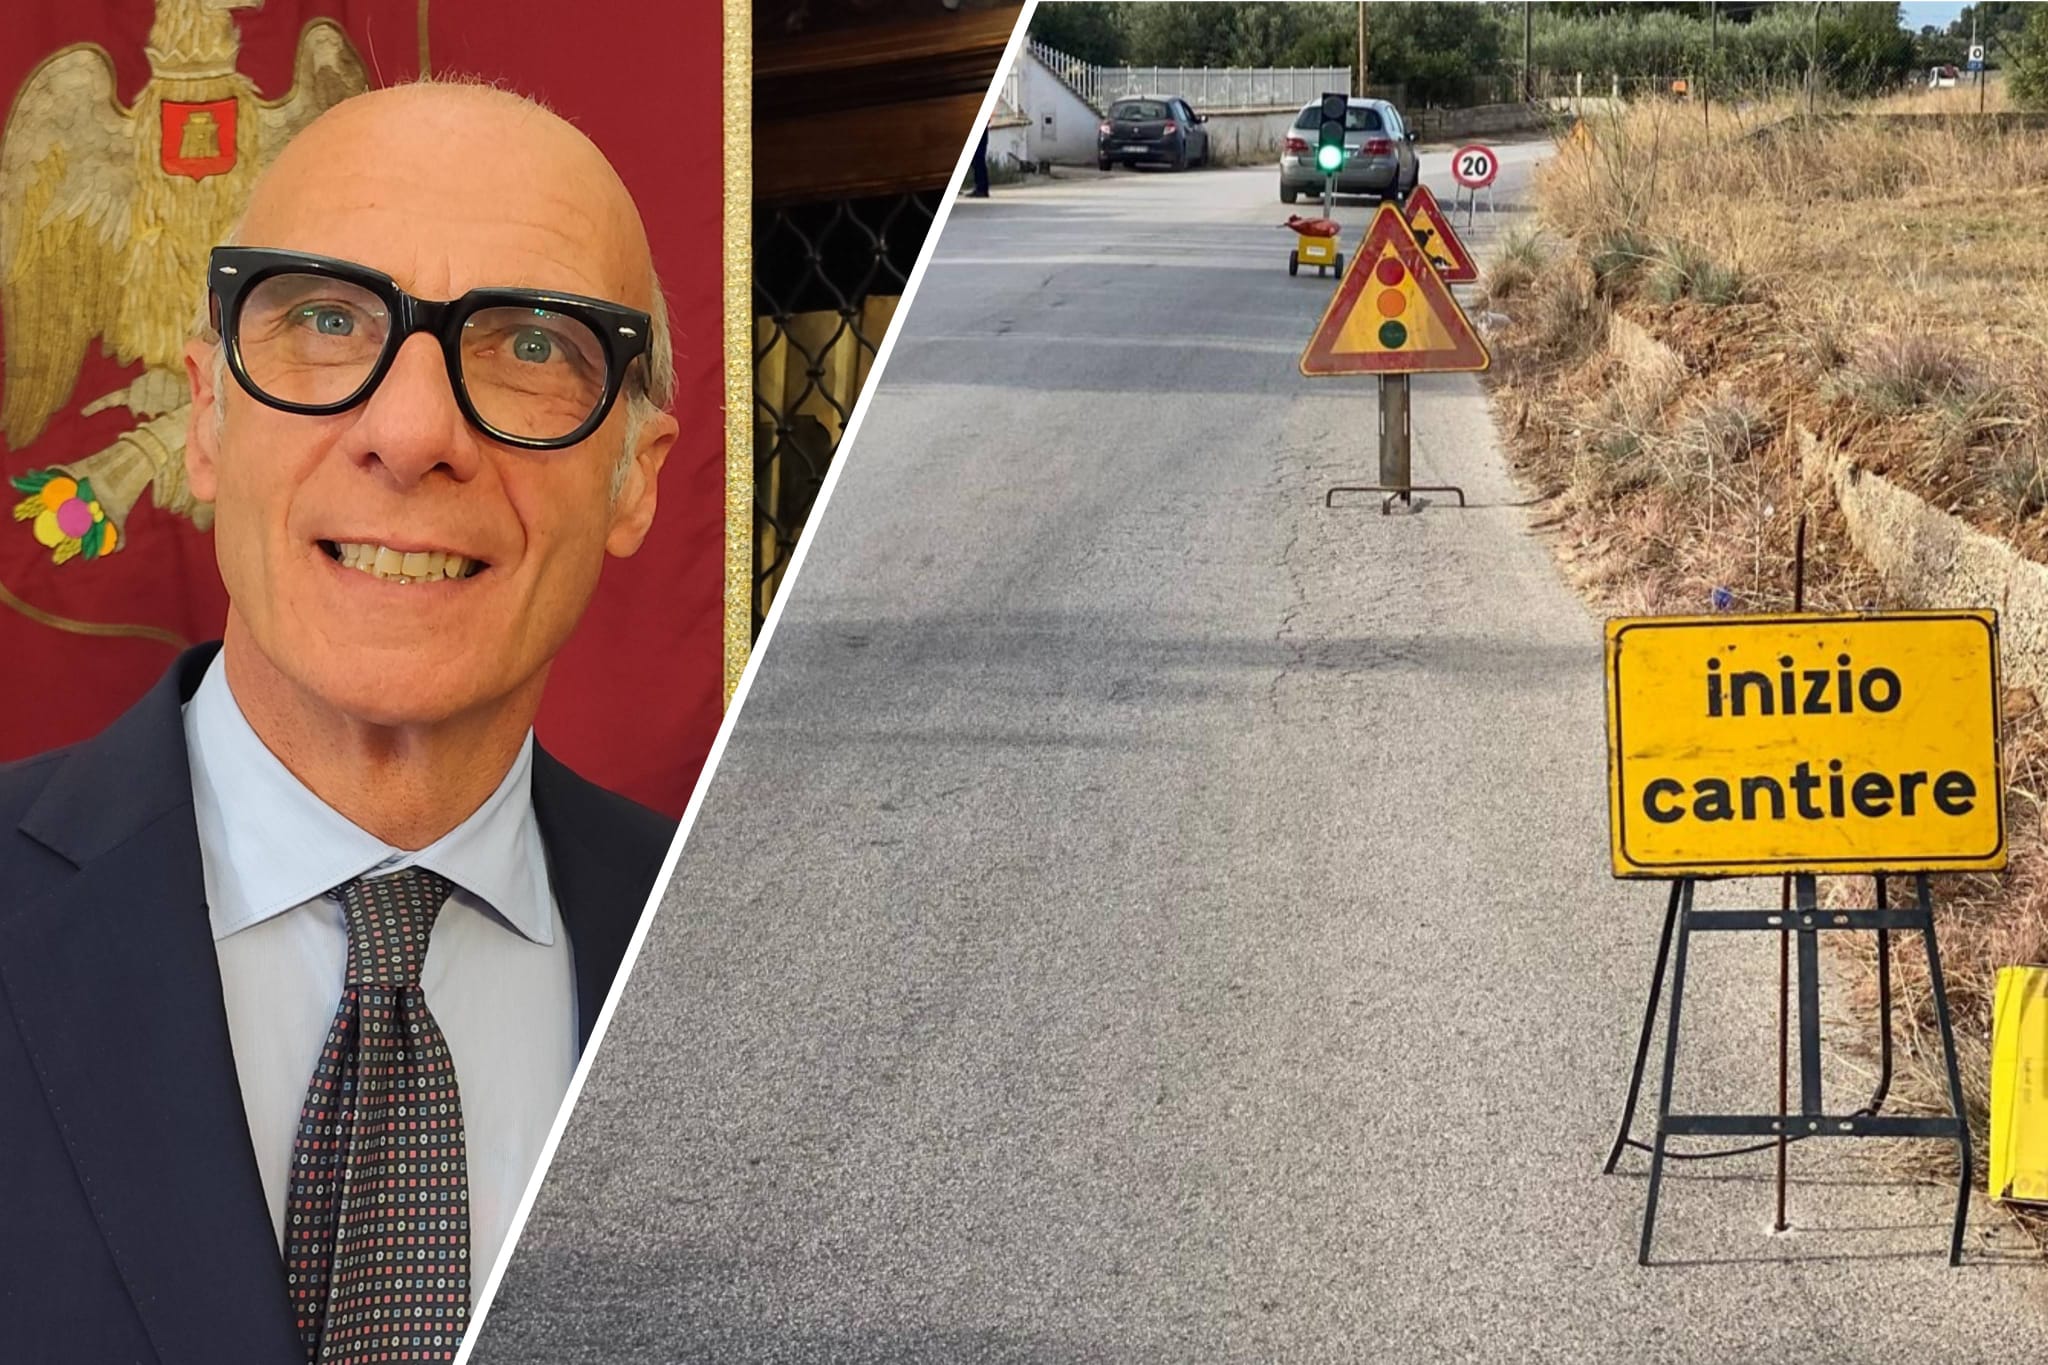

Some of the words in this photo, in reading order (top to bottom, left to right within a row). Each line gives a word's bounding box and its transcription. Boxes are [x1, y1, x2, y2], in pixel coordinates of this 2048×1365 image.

[1463, 156, 1487, 176] 20
[1706, 654, 1902, 717] inizio
[1642, 759, 1977, 824] cantiere
